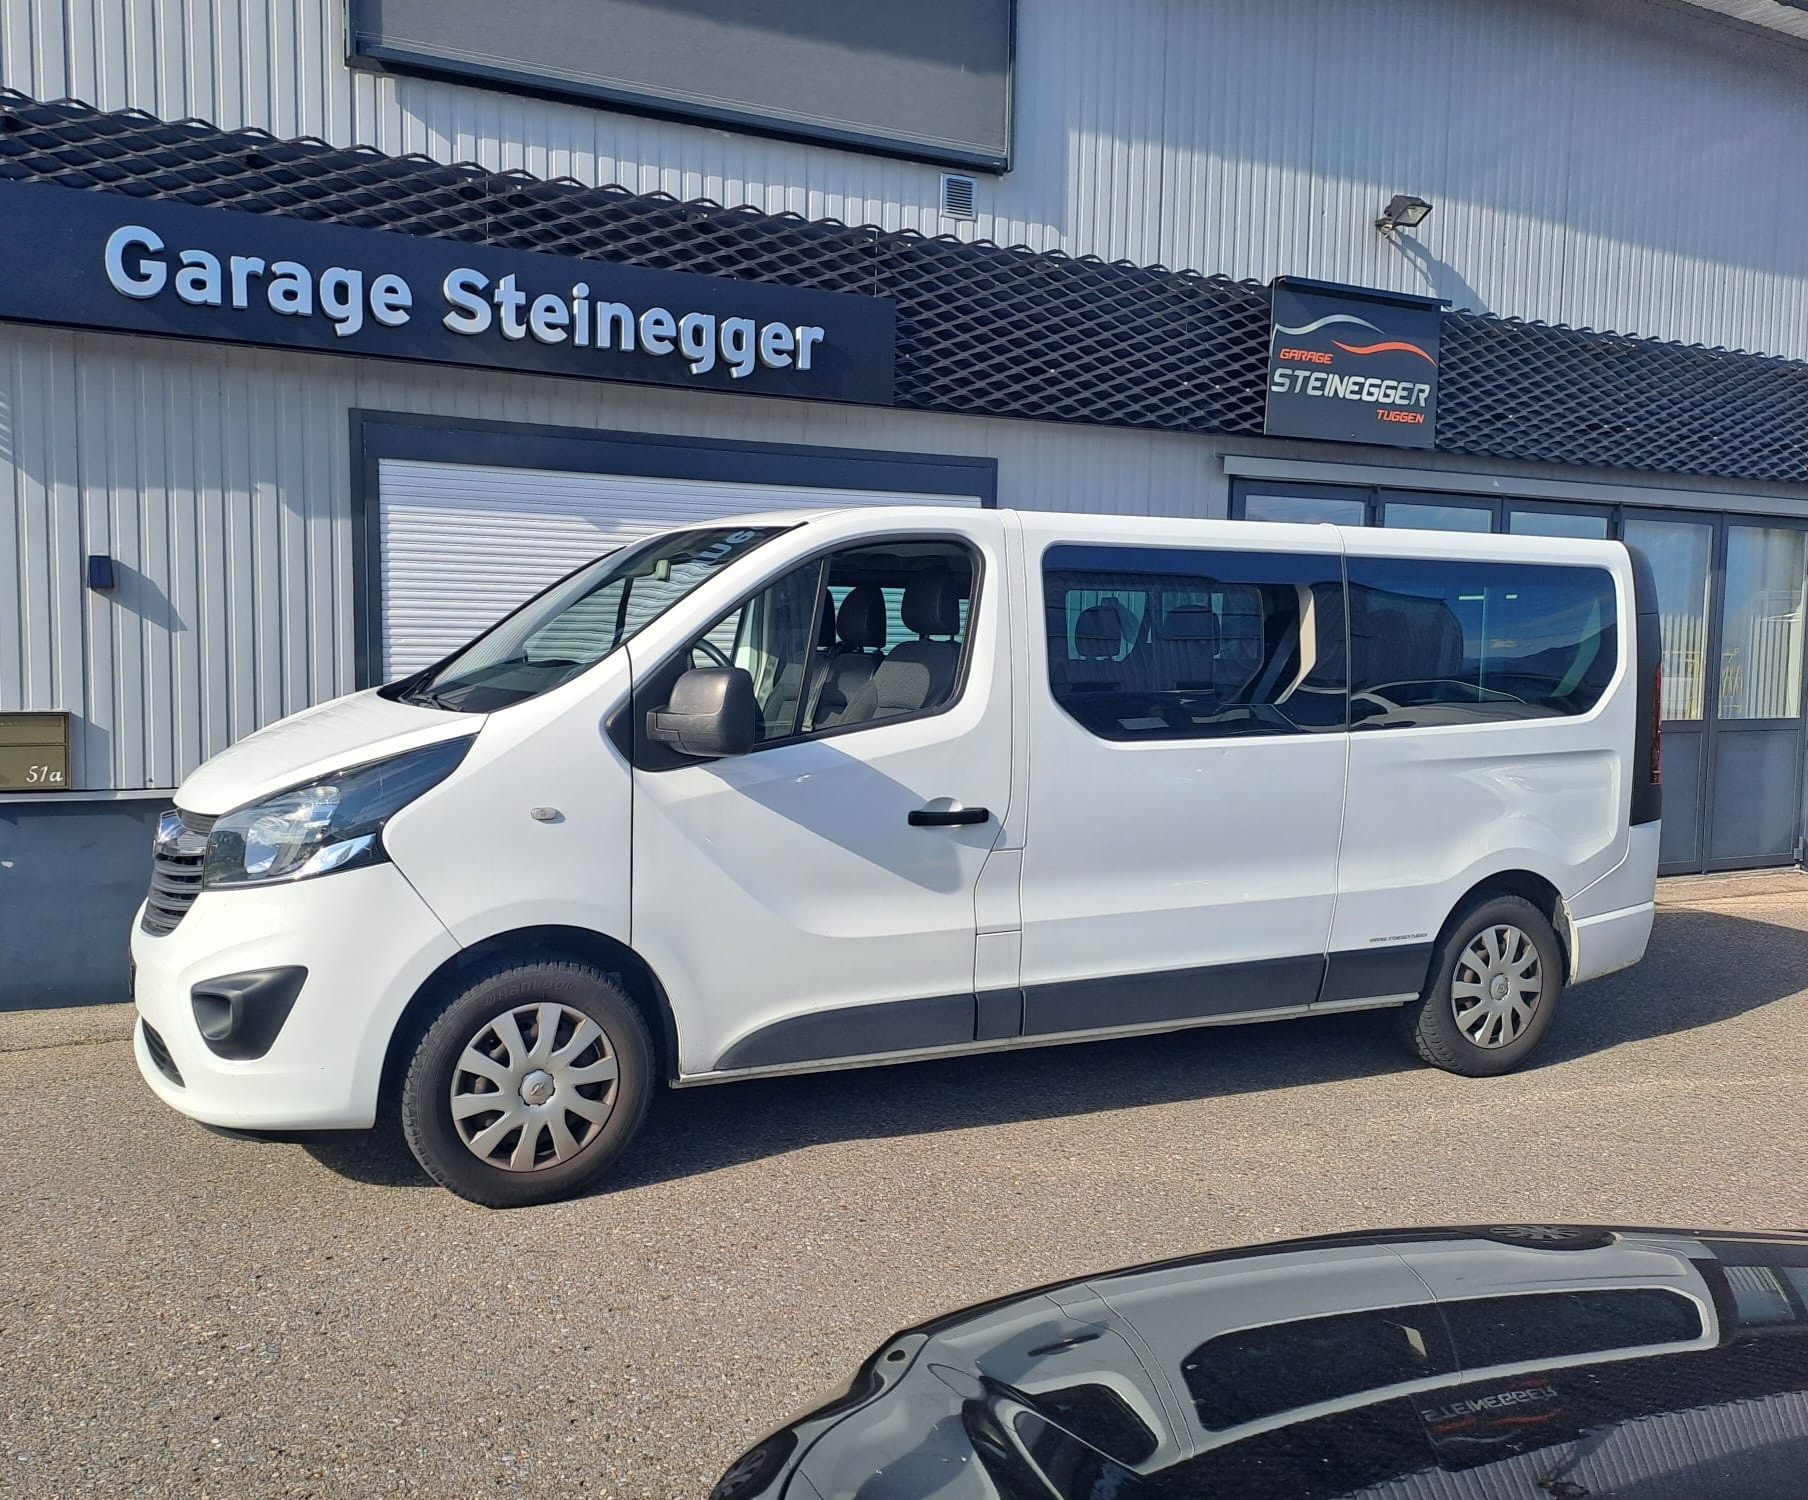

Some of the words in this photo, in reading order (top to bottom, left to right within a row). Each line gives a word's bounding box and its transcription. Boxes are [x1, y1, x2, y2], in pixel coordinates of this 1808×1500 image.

[104, 225, 412, 336] Garage
[443, 268, 824, 379] Steinegger
[1279, 348, 1334, 364] GARAGE
[1271, 368, 1431, 407] STEINEGGER
[1376, 409, 1424, 424] TUGGEN
[26, 765, 63, 783] 51a
